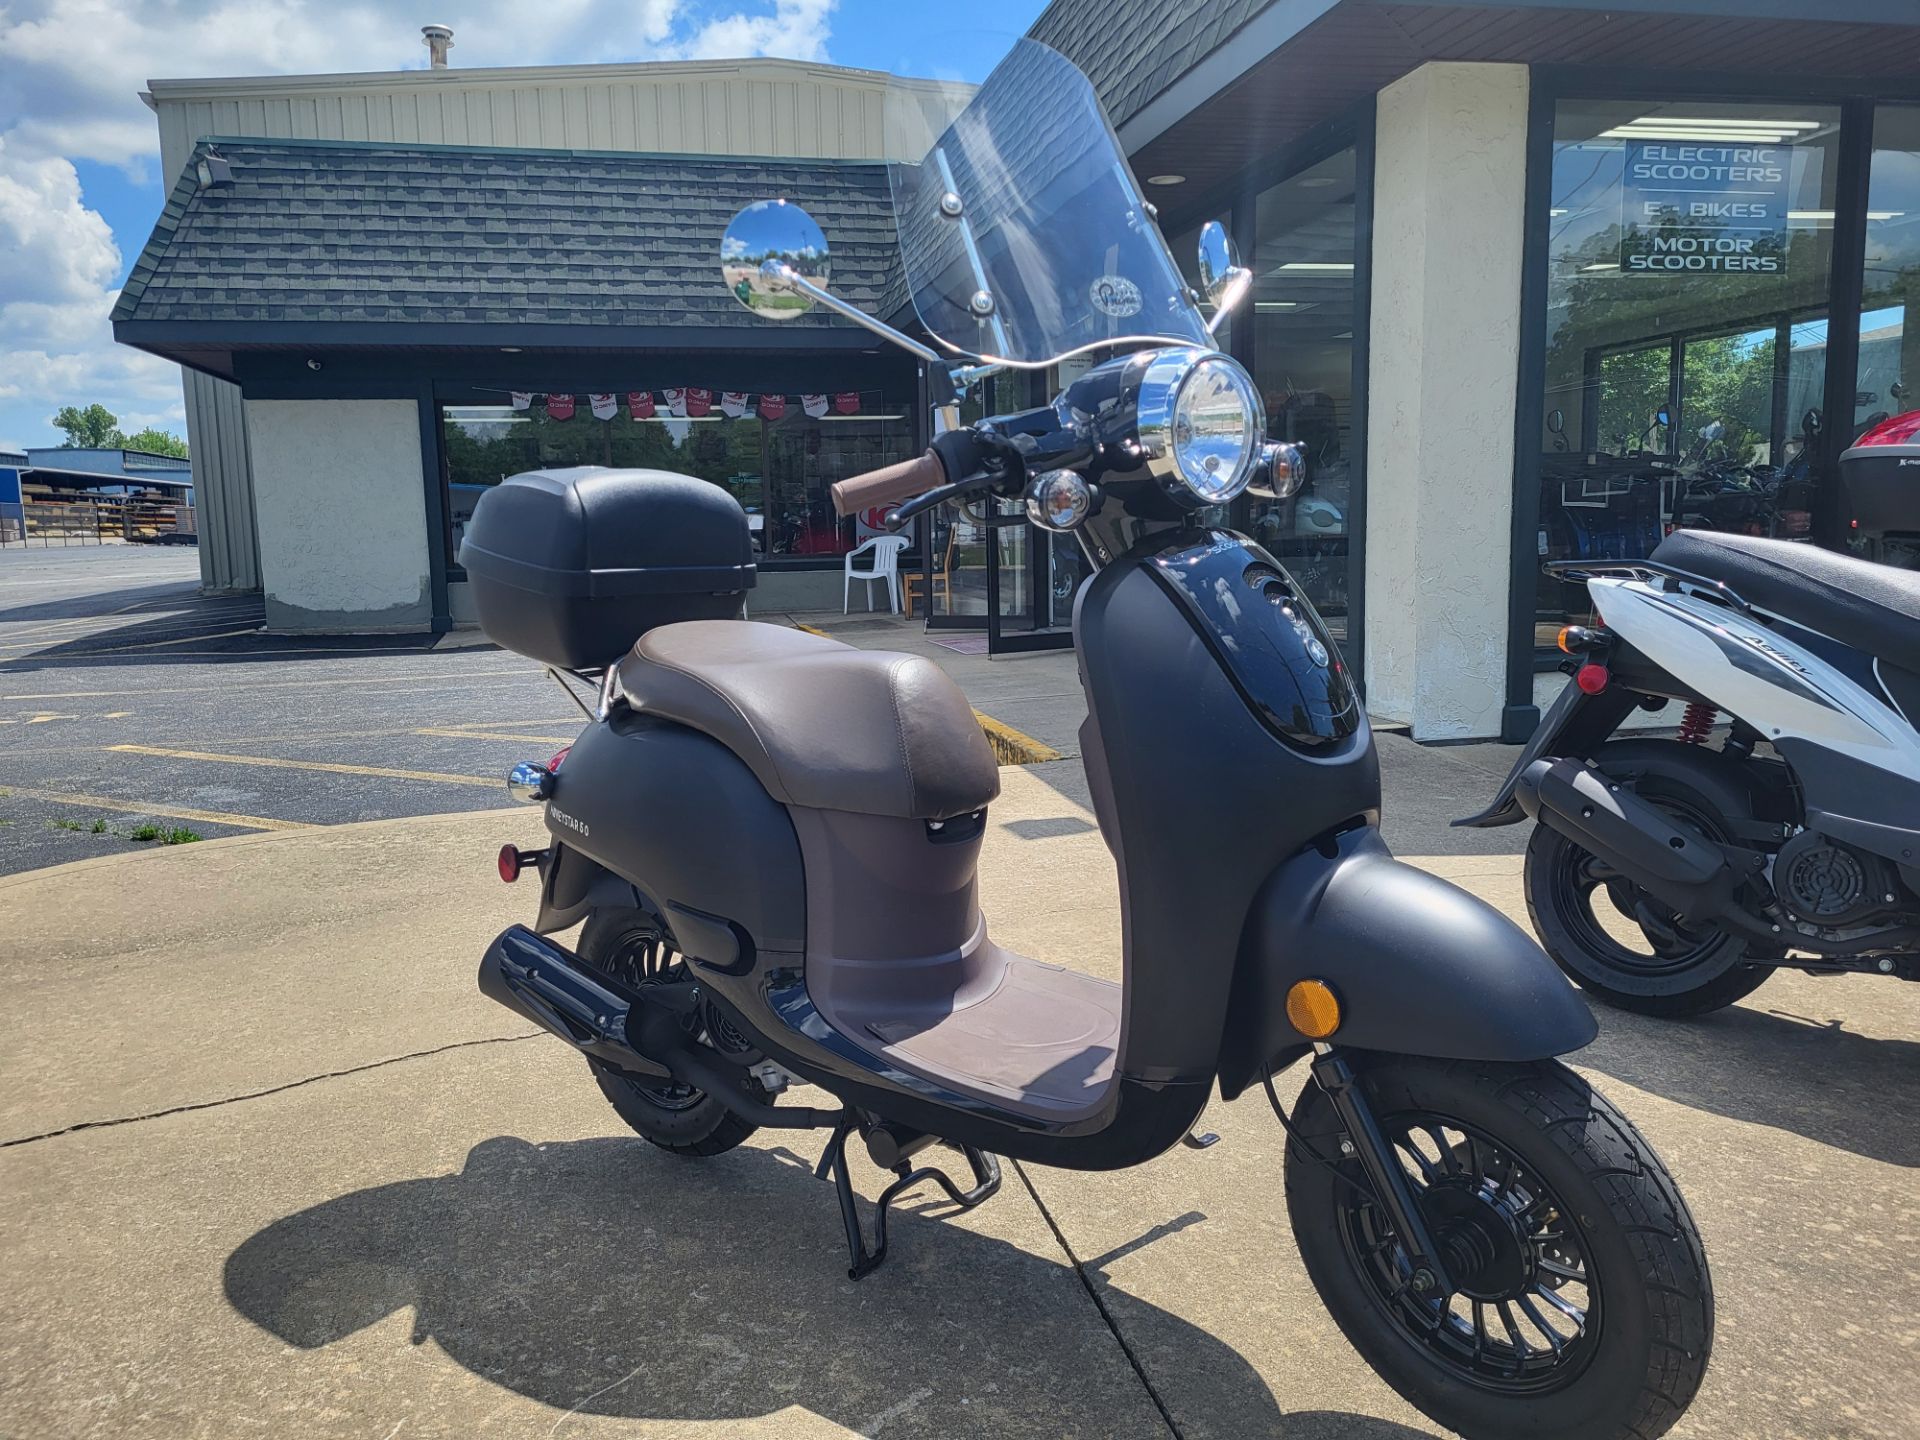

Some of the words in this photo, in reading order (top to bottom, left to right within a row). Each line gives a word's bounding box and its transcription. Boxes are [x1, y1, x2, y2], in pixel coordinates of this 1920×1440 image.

[1642, 145, 1776, 164] ELECTRIC
[1633, 164, 1782, 182] SCOOTERS
[1690, 202, 1767, 218] BIKES
[1654, 237, 1754, 253] MOTOR
[1629, 255, 1778, 271] SCOOTERS
